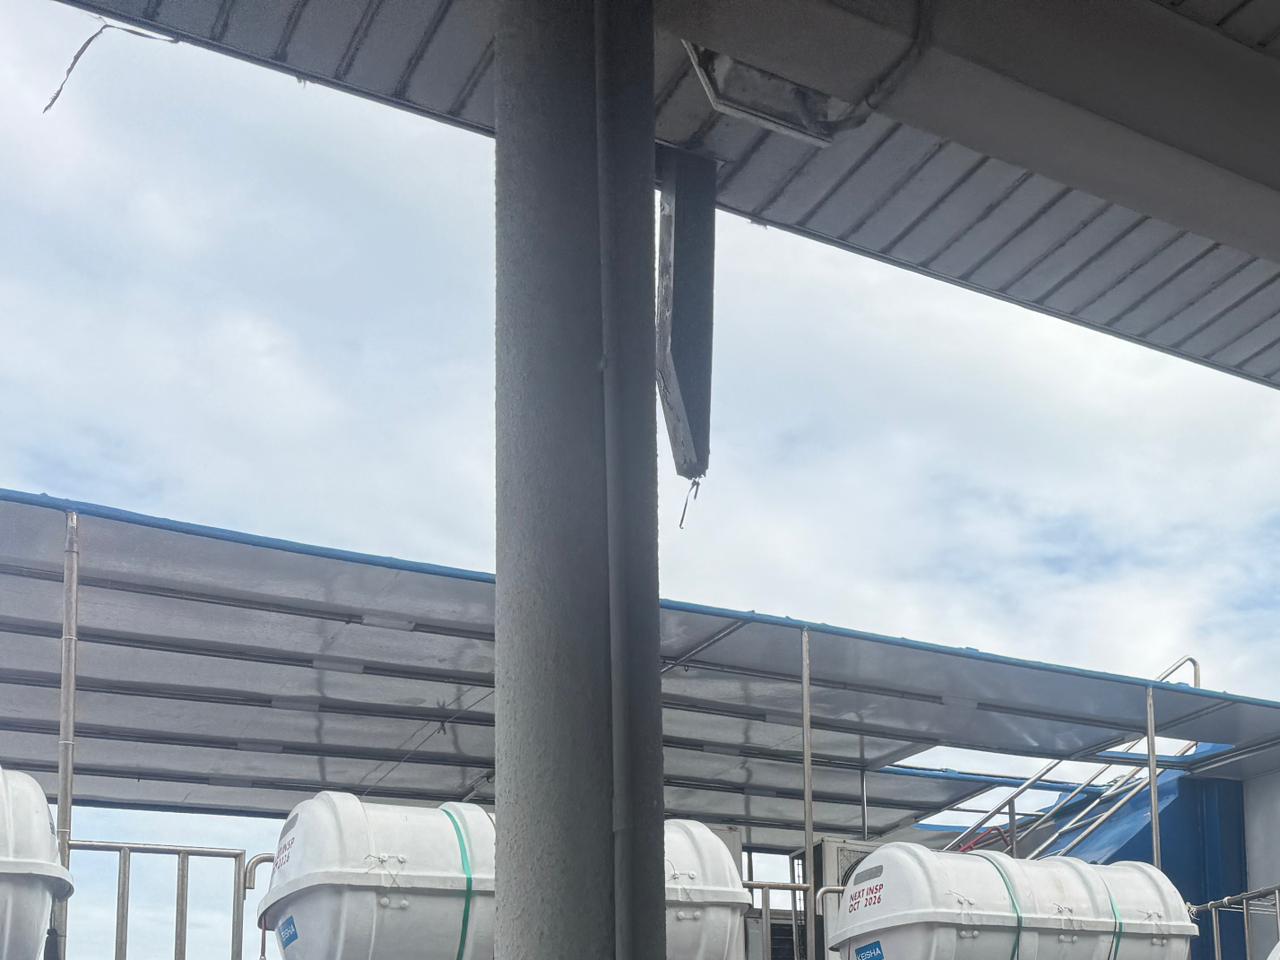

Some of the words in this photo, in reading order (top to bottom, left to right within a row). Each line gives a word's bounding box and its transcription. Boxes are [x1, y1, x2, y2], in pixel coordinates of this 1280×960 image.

[850, 888, 865, 903] NEXT
[866, 883, 884, 896] INSP
[848, 901, 861, 914] OCT
[864, 895, 882, 908] 2026
